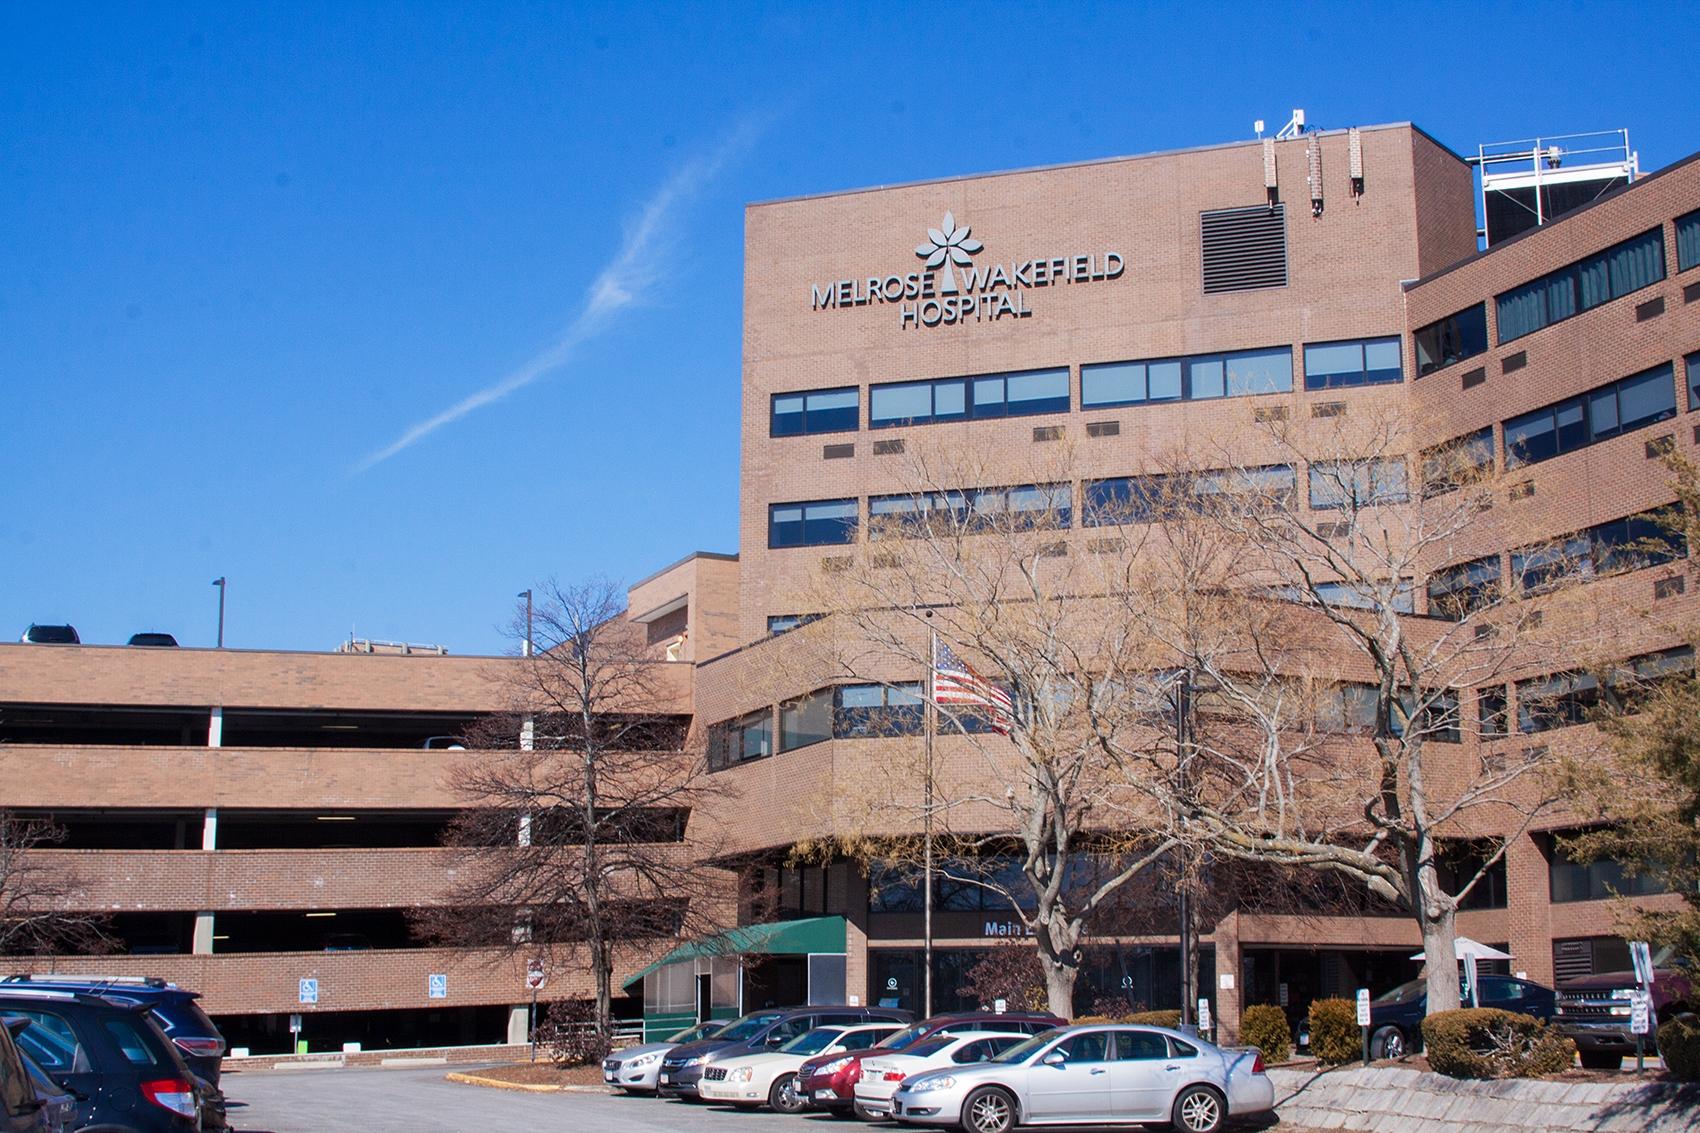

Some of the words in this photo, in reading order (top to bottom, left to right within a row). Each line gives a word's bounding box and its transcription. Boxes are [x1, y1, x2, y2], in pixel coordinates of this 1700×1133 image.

[811, 271, 936, 309] MELROSE
[959, 250, 1125, 292] WAKEFIELD
[900, 291, 1032, 328] HOSPITAL
